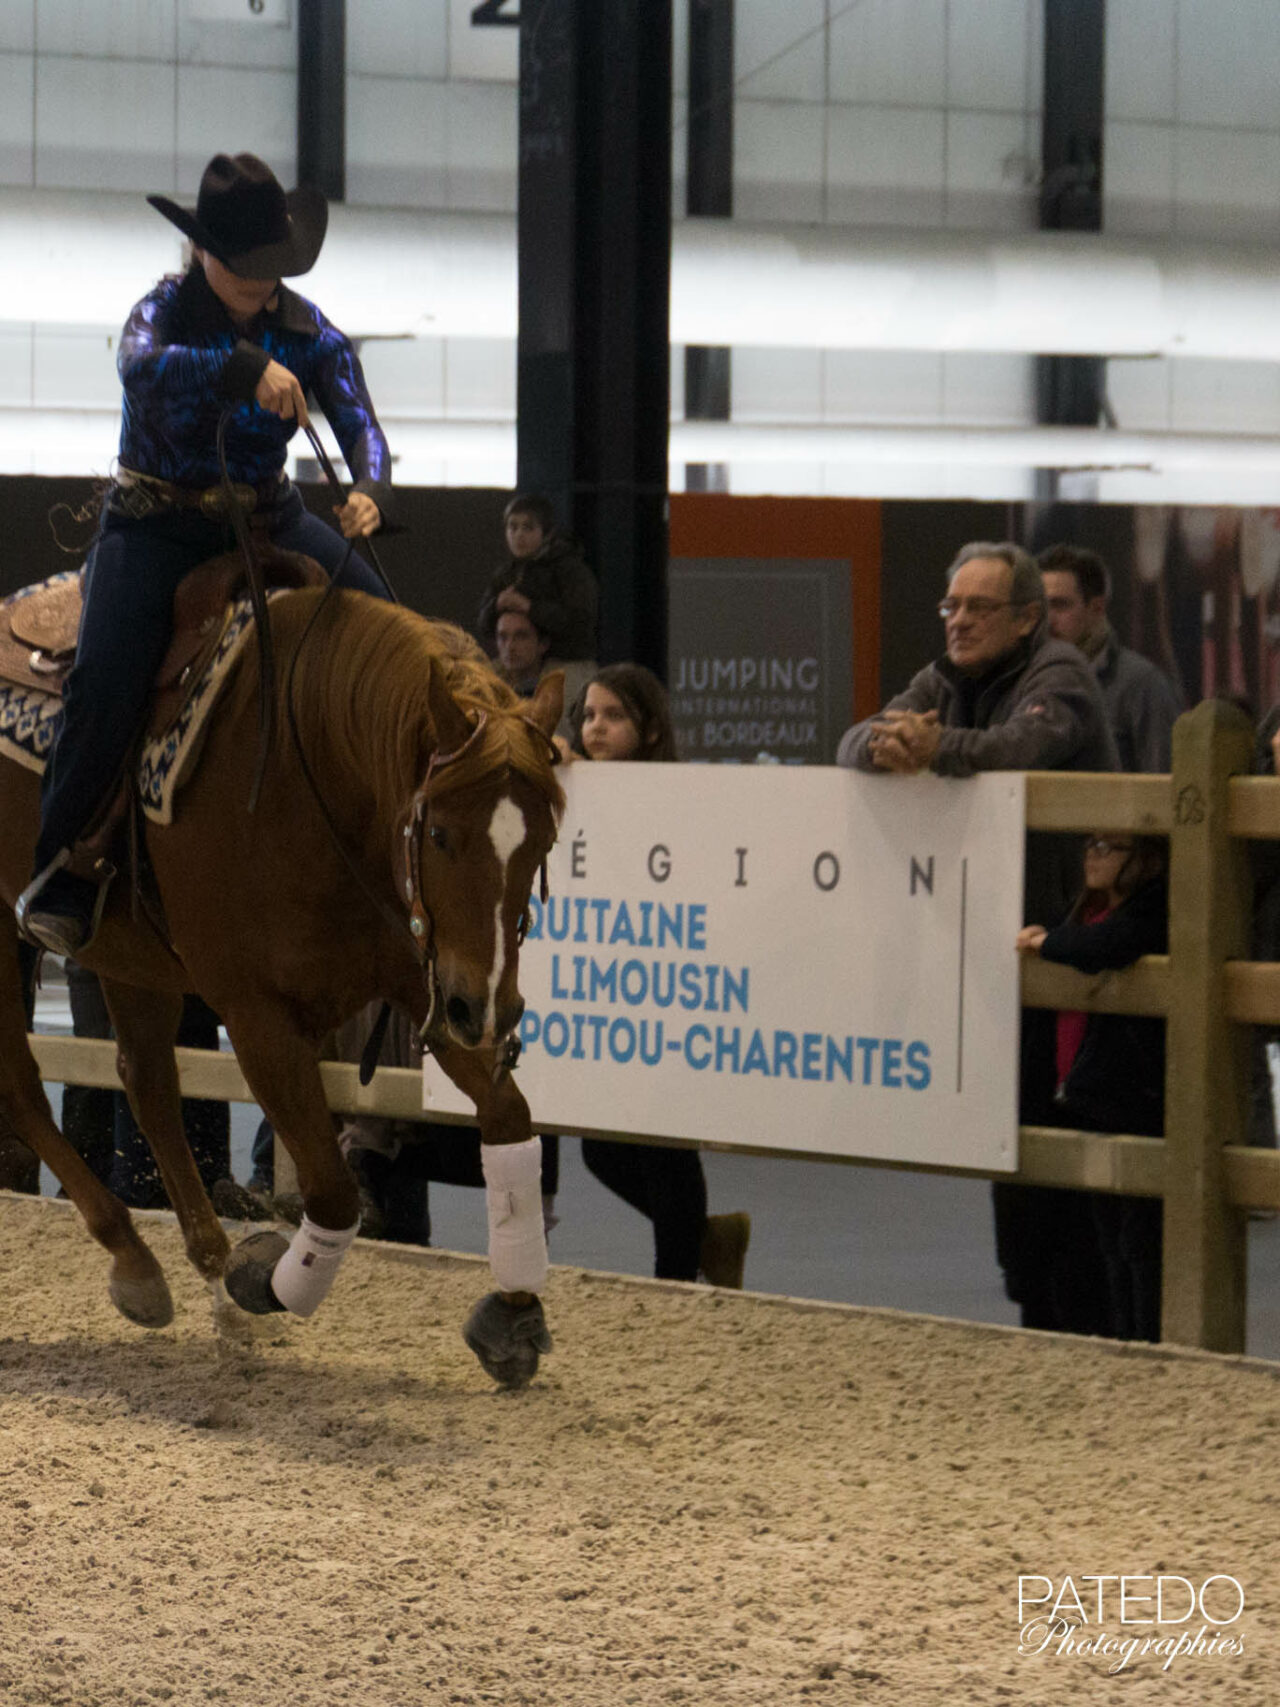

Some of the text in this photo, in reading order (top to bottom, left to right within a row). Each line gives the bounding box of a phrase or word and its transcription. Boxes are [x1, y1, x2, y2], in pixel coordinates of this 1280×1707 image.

[676, 658, 818, 690] JUMPING
[703, 721, 817, 746] BORDEAUX
[570, 830, 936, 896] ÉGION
[518, 894, 707, 950] QUITAINE
[551, 954, 749, 1013] LIMOUSIN
[519, 1009, 932, 1092] POITOU-CHARENTES
